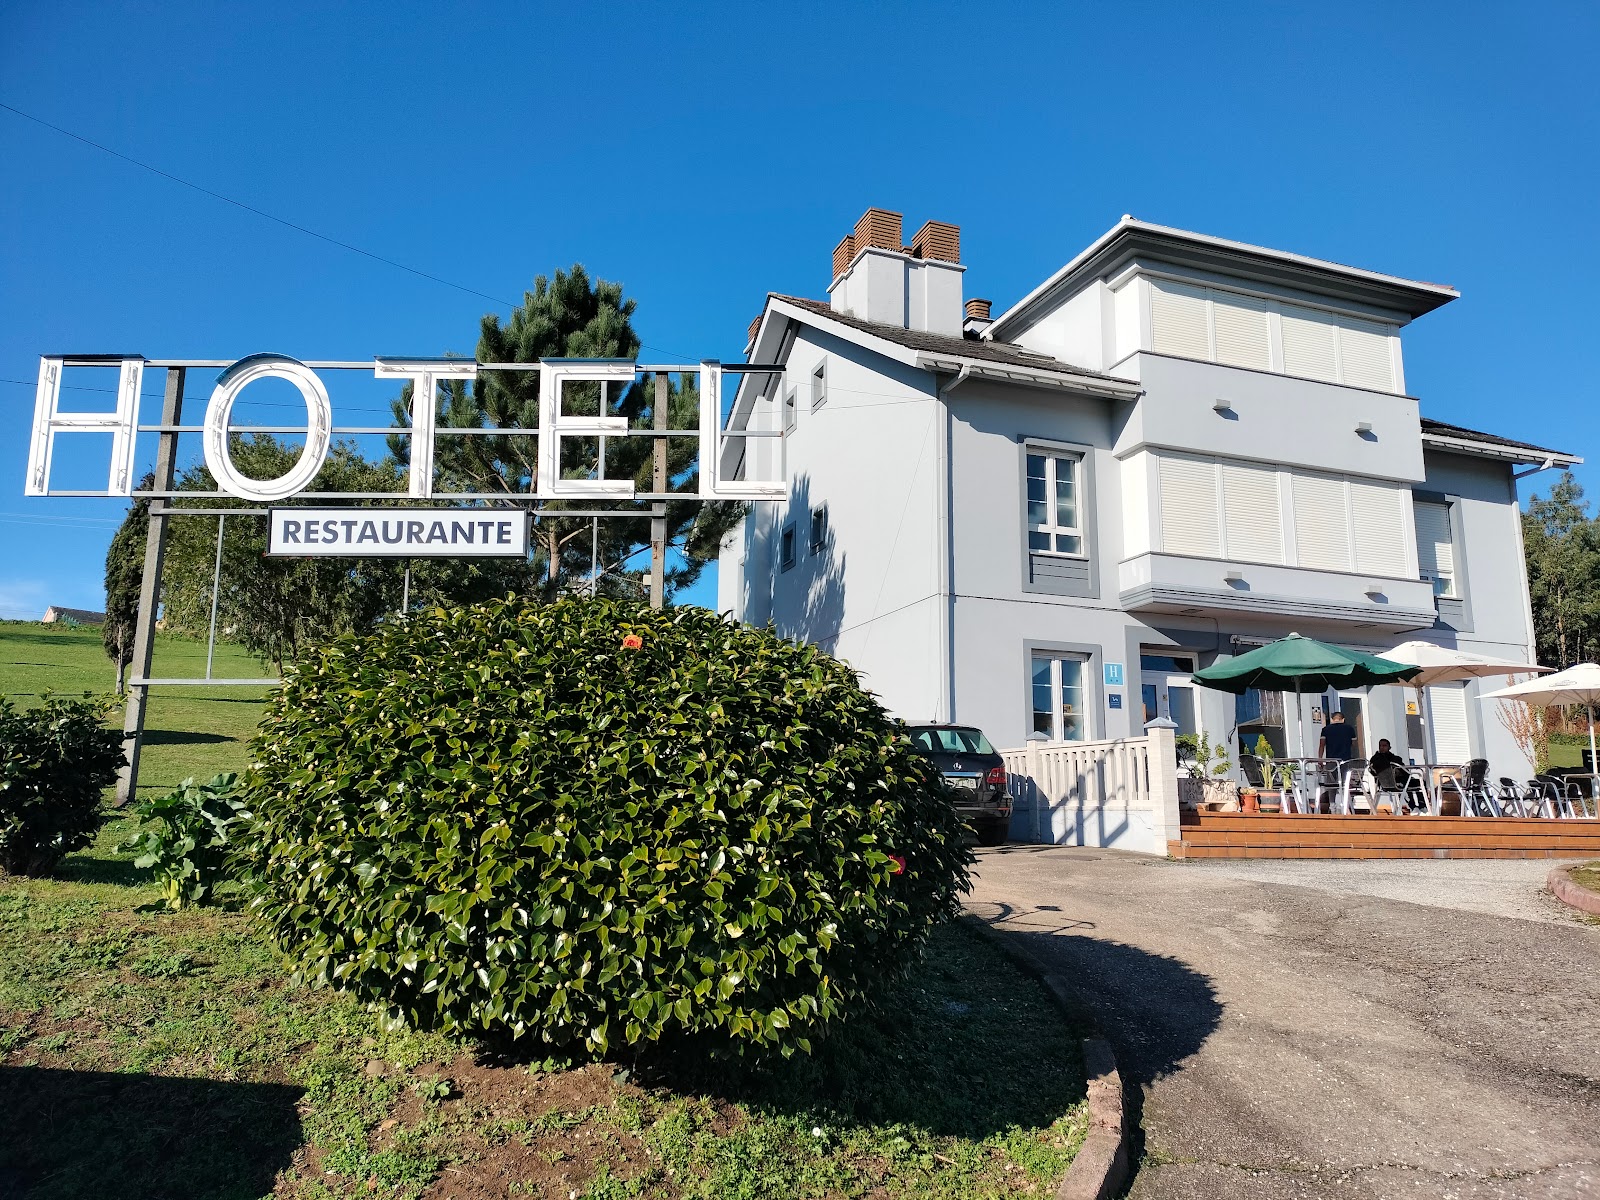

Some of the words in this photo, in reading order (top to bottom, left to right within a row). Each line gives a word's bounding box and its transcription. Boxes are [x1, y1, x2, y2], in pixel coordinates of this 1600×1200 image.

[24, 352, 786, 501] HOTEL
[282, 519, 512, 544] RESTAURANTE
[1110, 665, 1118, 678] H
